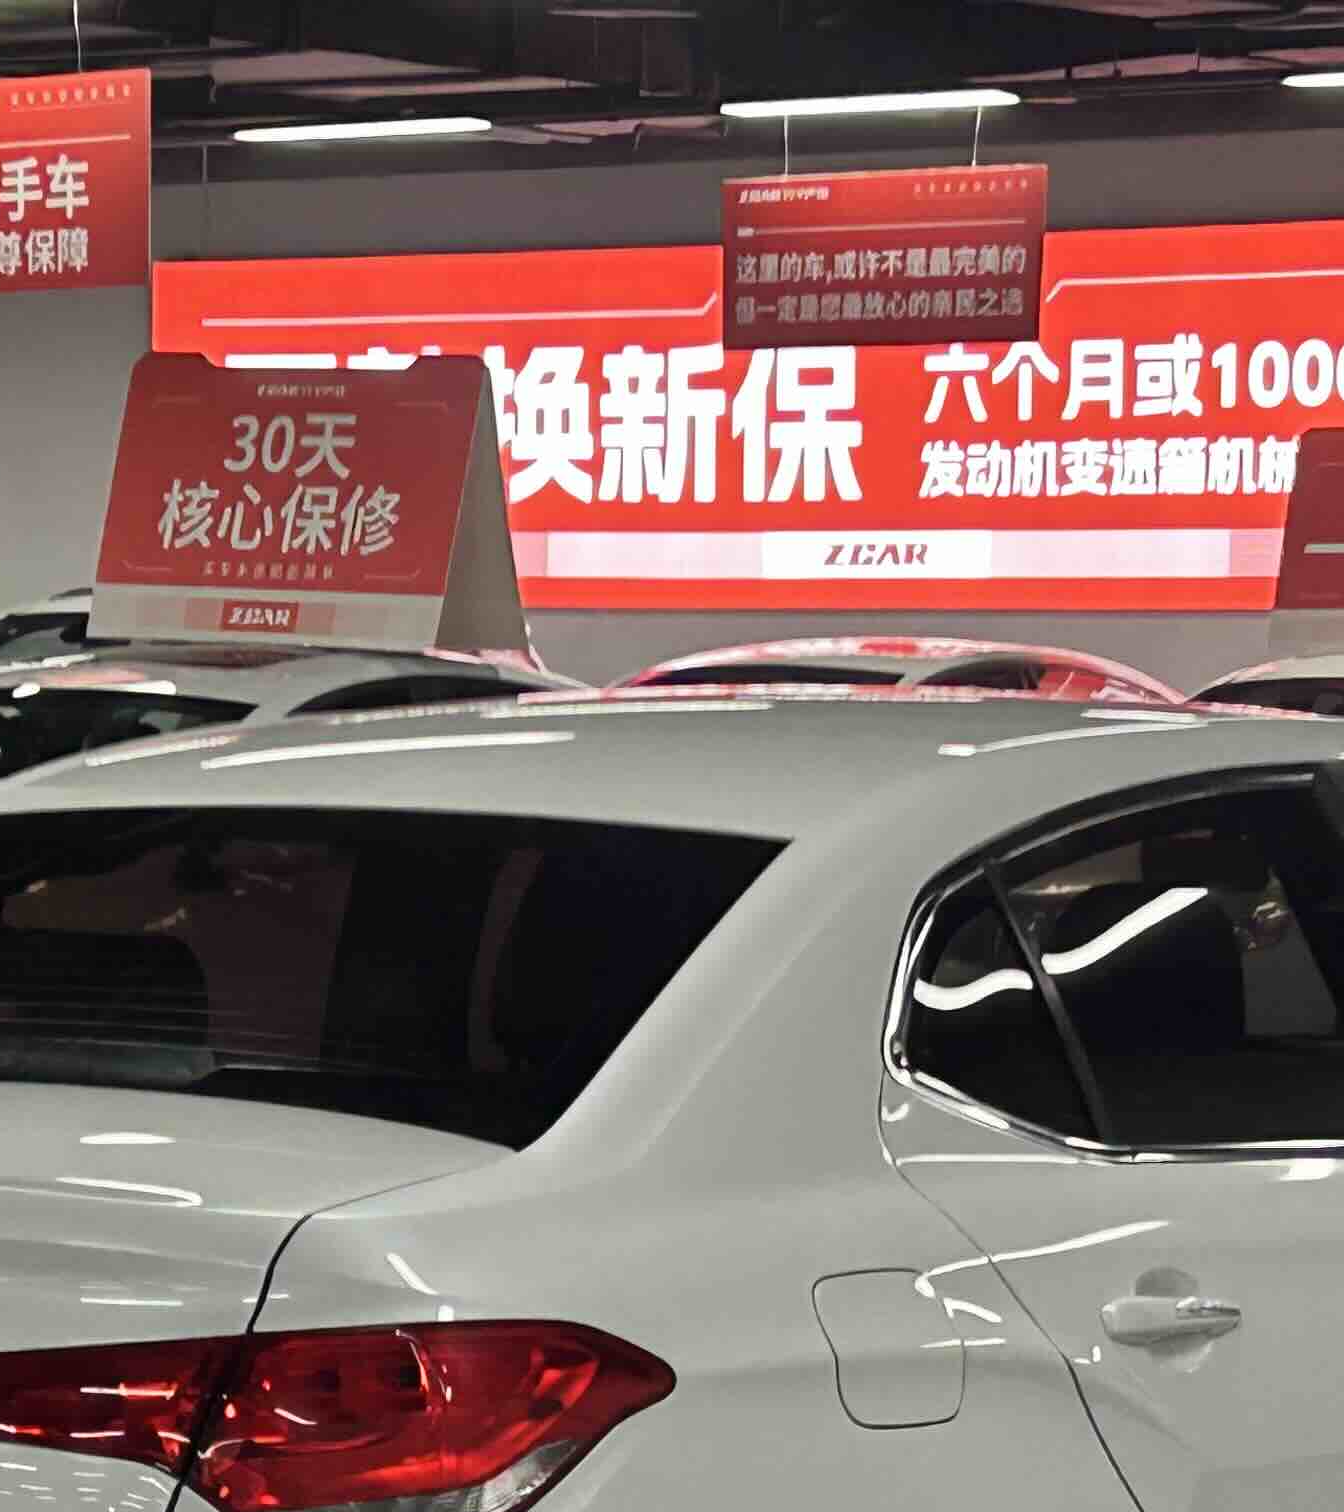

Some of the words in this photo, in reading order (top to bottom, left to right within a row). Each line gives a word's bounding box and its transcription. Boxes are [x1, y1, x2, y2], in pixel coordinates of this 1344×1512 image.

[223, 413, 357, 480] 30天
[158, 479, 402, 557] 核心保修
